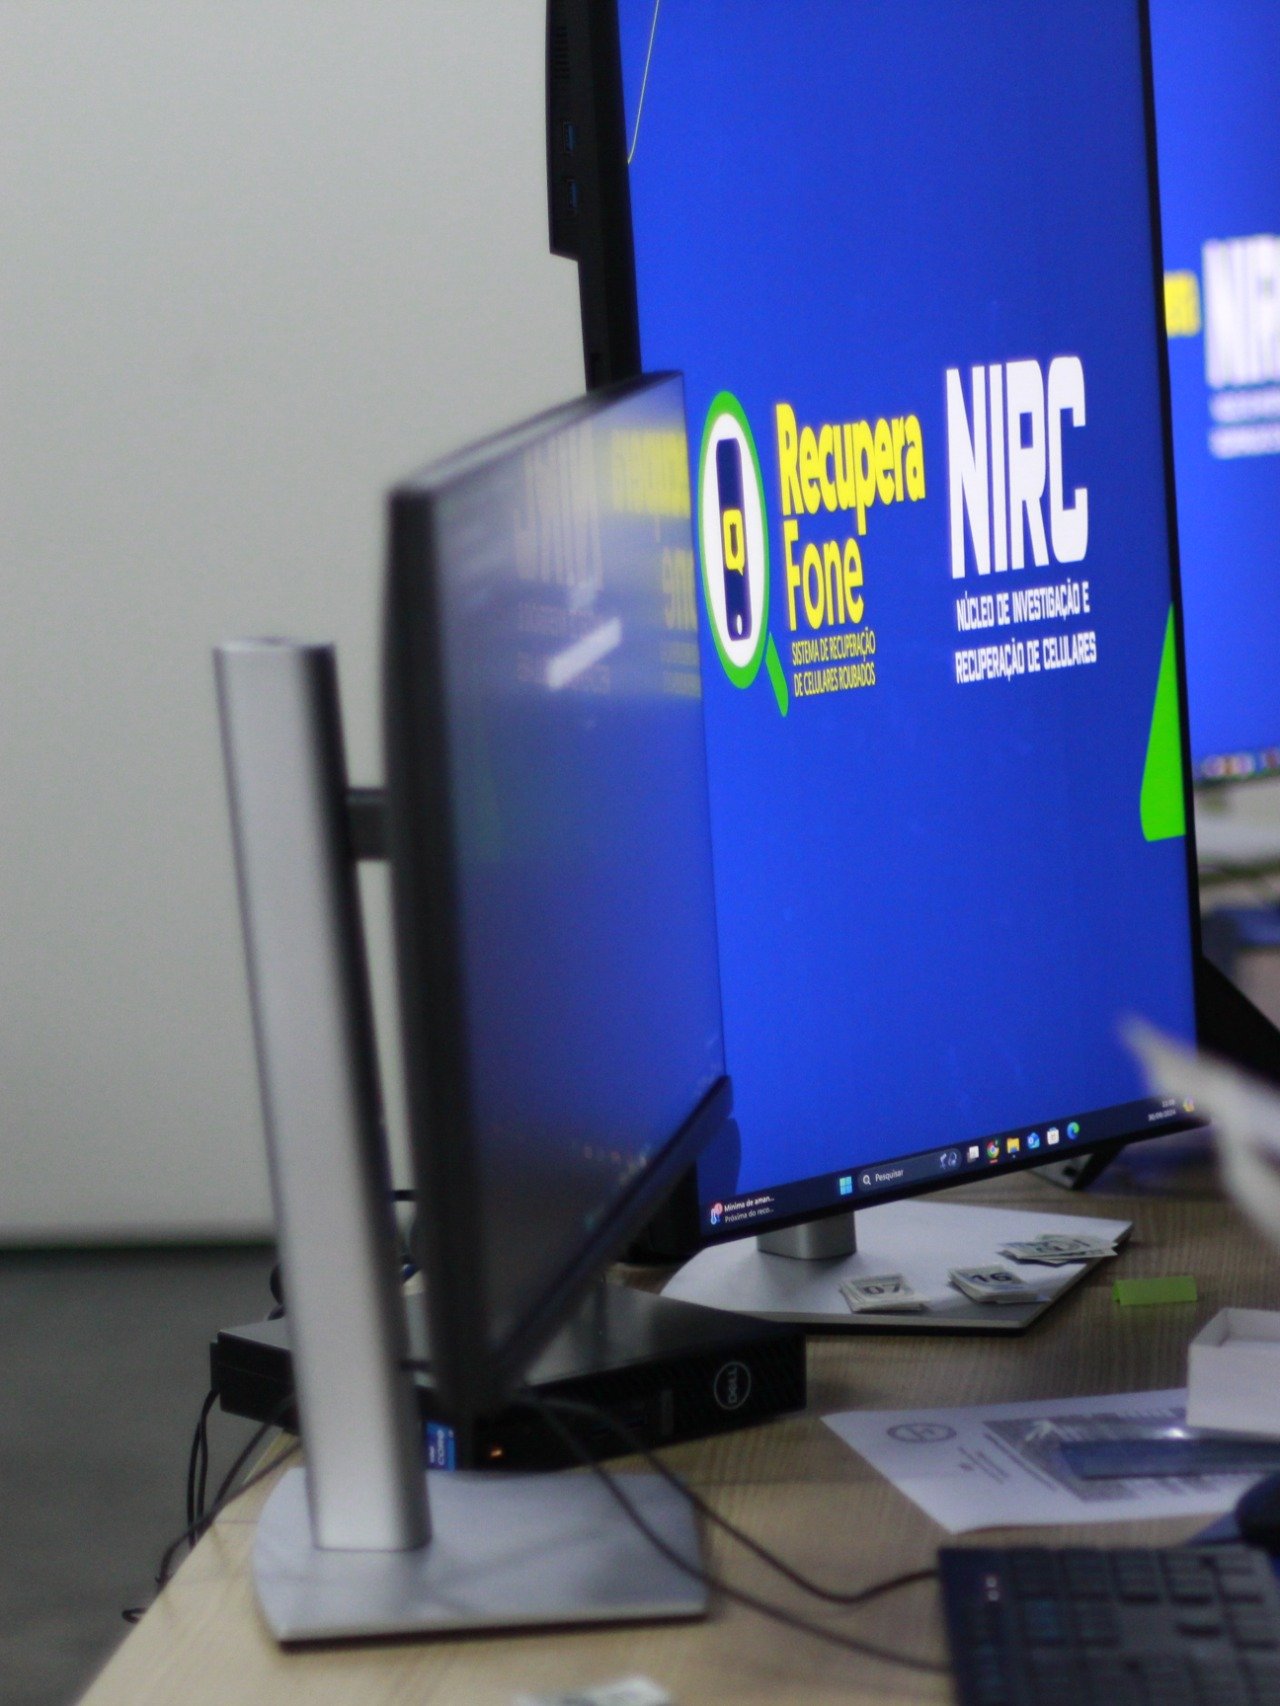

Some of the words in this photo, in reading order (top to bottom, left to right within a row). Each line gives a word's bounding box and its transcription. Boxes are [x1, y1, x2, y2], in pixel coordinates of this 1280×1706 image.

[775, 403, 926, 535] Recupera
[946, 356, 1089, 578] NIRC
[783, 519, 865, 631] Fone
[956, 590, 994, 632] NÚCLEO
[996, 592, 1010, 626] DE
[1012, 577, 1081, 624] INVESTIGAÇÃO
[1082, 580, 1091, 613] E
[792, 638, 821, 666] SISTEMA
[820, 637, 829, 662] DE
[829, 626, 876, 662] RECUPERAÇÃO
[955, 637, 1025, 684] RECUPERAÇÃO
[1026, 639, 1041, 672] DE
[1043, 631, 1098, 670] CELULARES
[794, 672, 804, 698] DE
[804, 667, 839, 696] CELULARES
[838, 661, 876, 691] ROUBADOS
[875, 1169, 904, 1182] Pesquisar
[746, 1198, 754, 1207] de
